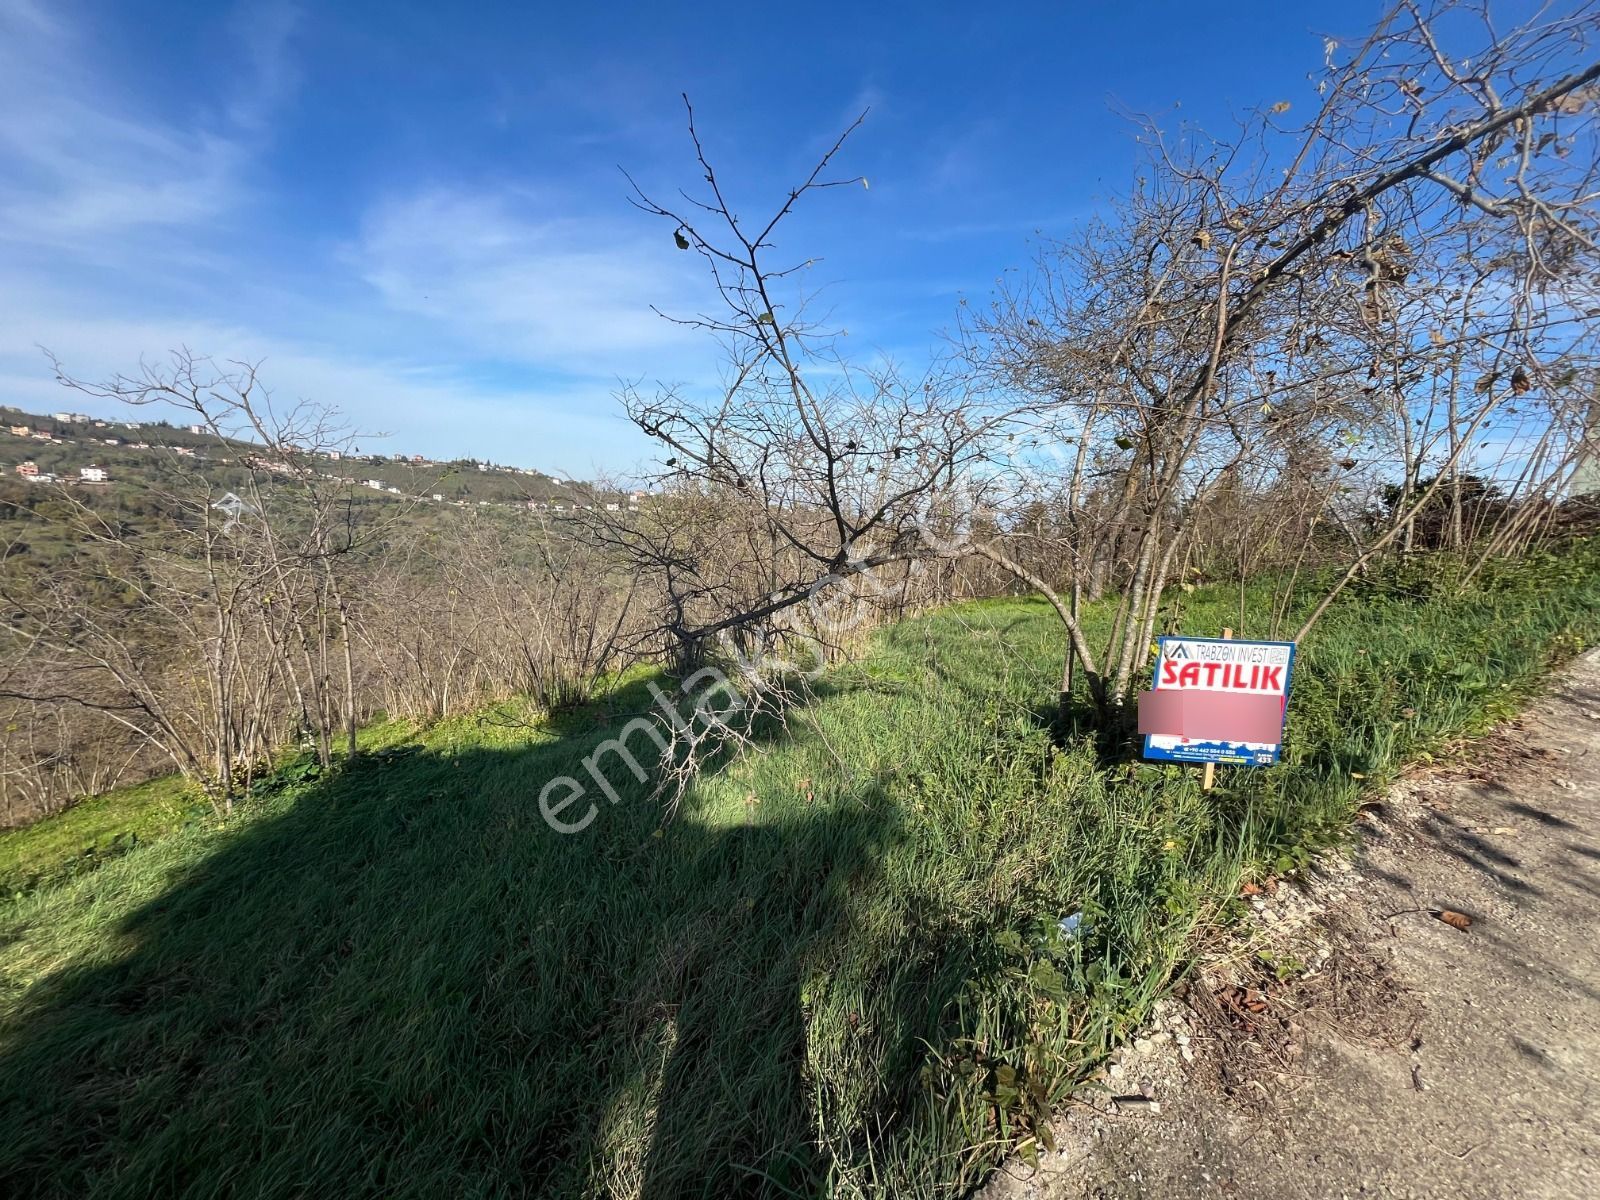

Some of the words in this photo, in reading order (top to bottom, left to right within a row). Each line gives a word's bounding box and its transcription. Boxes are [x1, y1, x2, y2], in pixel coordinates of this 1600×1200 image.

[1196, 644, 1237, 662] TRABZON
[1237, 646, 1268, 664] INVEST
[1162, 661, 1283, 691] SATILIK
